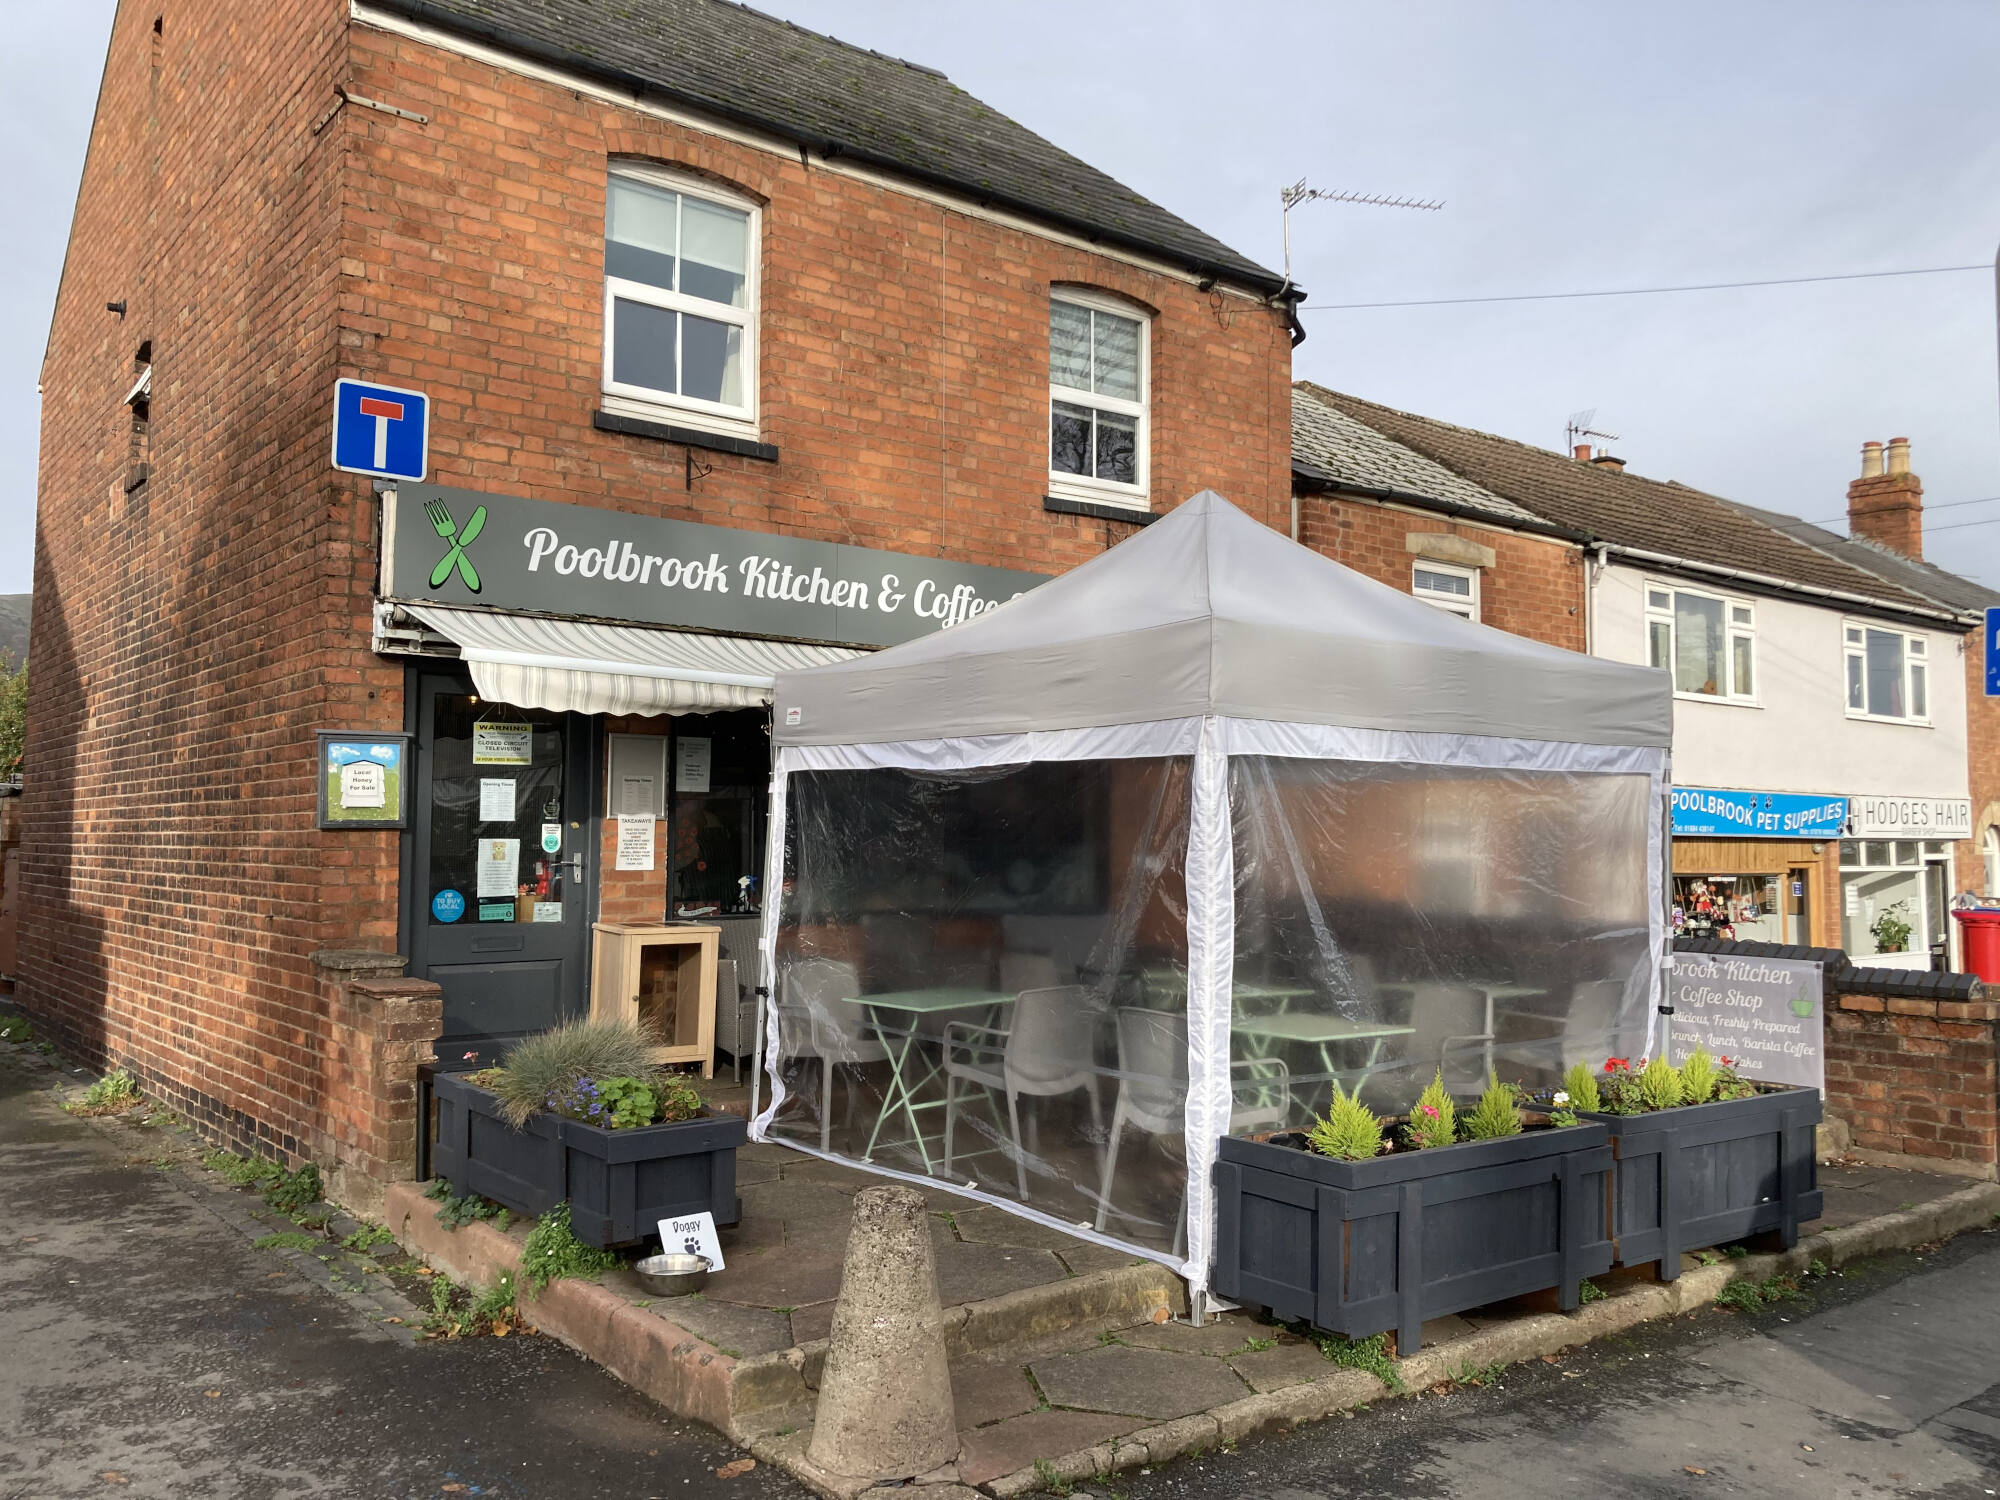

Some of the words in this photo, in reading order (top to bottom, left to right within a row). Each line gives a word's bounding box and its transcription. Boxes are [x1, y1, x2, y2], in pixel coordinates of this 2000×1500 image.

[524, 527, 729, 593] Poolbrook
[739, 555, 869, 610] Kitchen
[877, 574, 906, 613] &
[1671, 791, 1754, 827] POOLBROOK
[1756, 811, 1781, 831] PET
[1783, 802, 1843, 831] SUPPLIES
[1865, 801, 1928, 825] HODGES
[1935, 803, 1968, 826] HAIR
[1724, 960, 1793, 985] Kitchen
[1680, 985, 1722, 1008] Coffee
[1725, 989, 1763, 1012] Shop
[1671, 1011, 1709, 1026] elicious,
[1713, 1014, 1749, 1031] Freshly
[1752, 1018, 1801, 1034] Prepared
[1707, 1033, 1738, 1048] Lunch,
[1742, 1037, 1781, 1051] Barista
[1783, 1040, 1816, 1057] Coffee
[673, 1220, 701, 1233] Doggy
